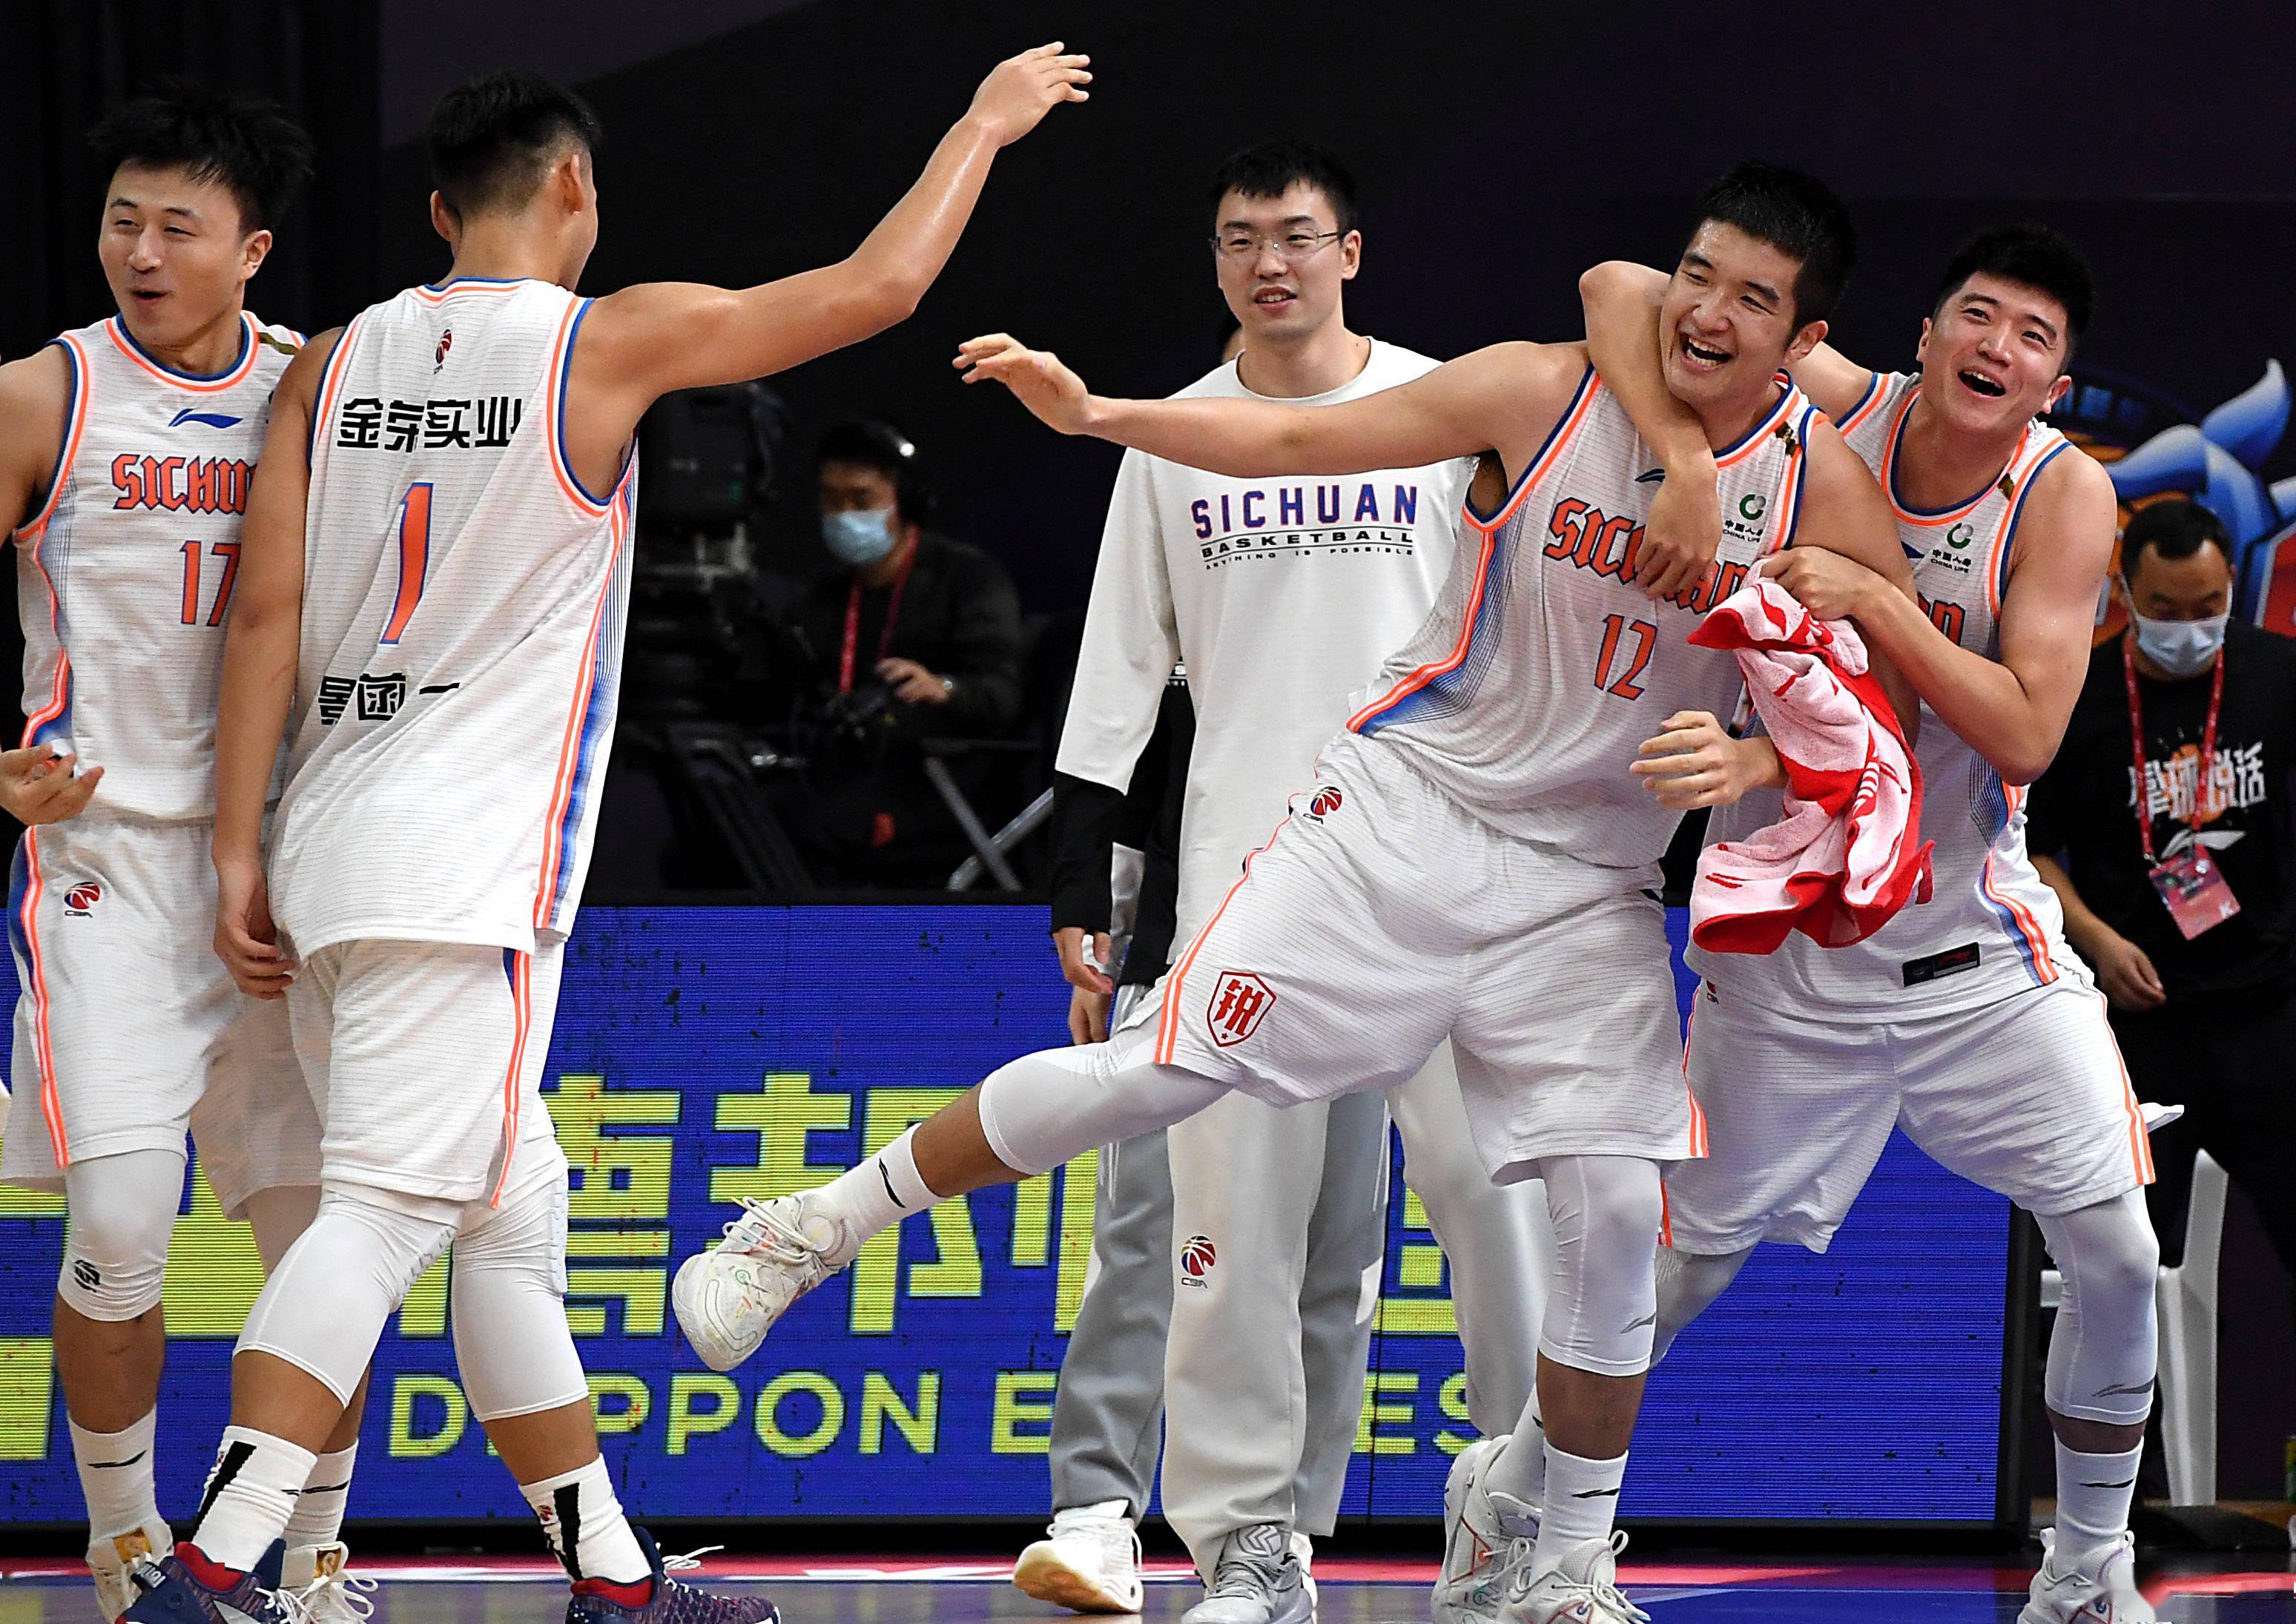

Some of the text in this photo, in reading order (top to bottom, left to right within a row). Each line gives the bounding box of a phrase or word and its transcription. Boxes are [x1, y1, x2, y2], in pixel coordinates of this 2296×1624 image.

[111, 453, 257, 516] SICHU
[1191, 483, 1417, 539] SICHUAN
[1201, 530, 1413, 558] BASKETBALL
[1206, 552, 1276, 570] ANYTHING
[1330, 547, 1413, 555] POSSIBLE
[1723, 529, 1745, 540] CHINA
[179, 540, 241, 627] 17
[380, 482, 434, 644] 1
[1930, 558, 1952, 570] CHINA
[1594, 614, 1658, 700] 12
[1181, 1278, 1207, 1289] CBA
[389, 1370, 940, 1458] DPPON
